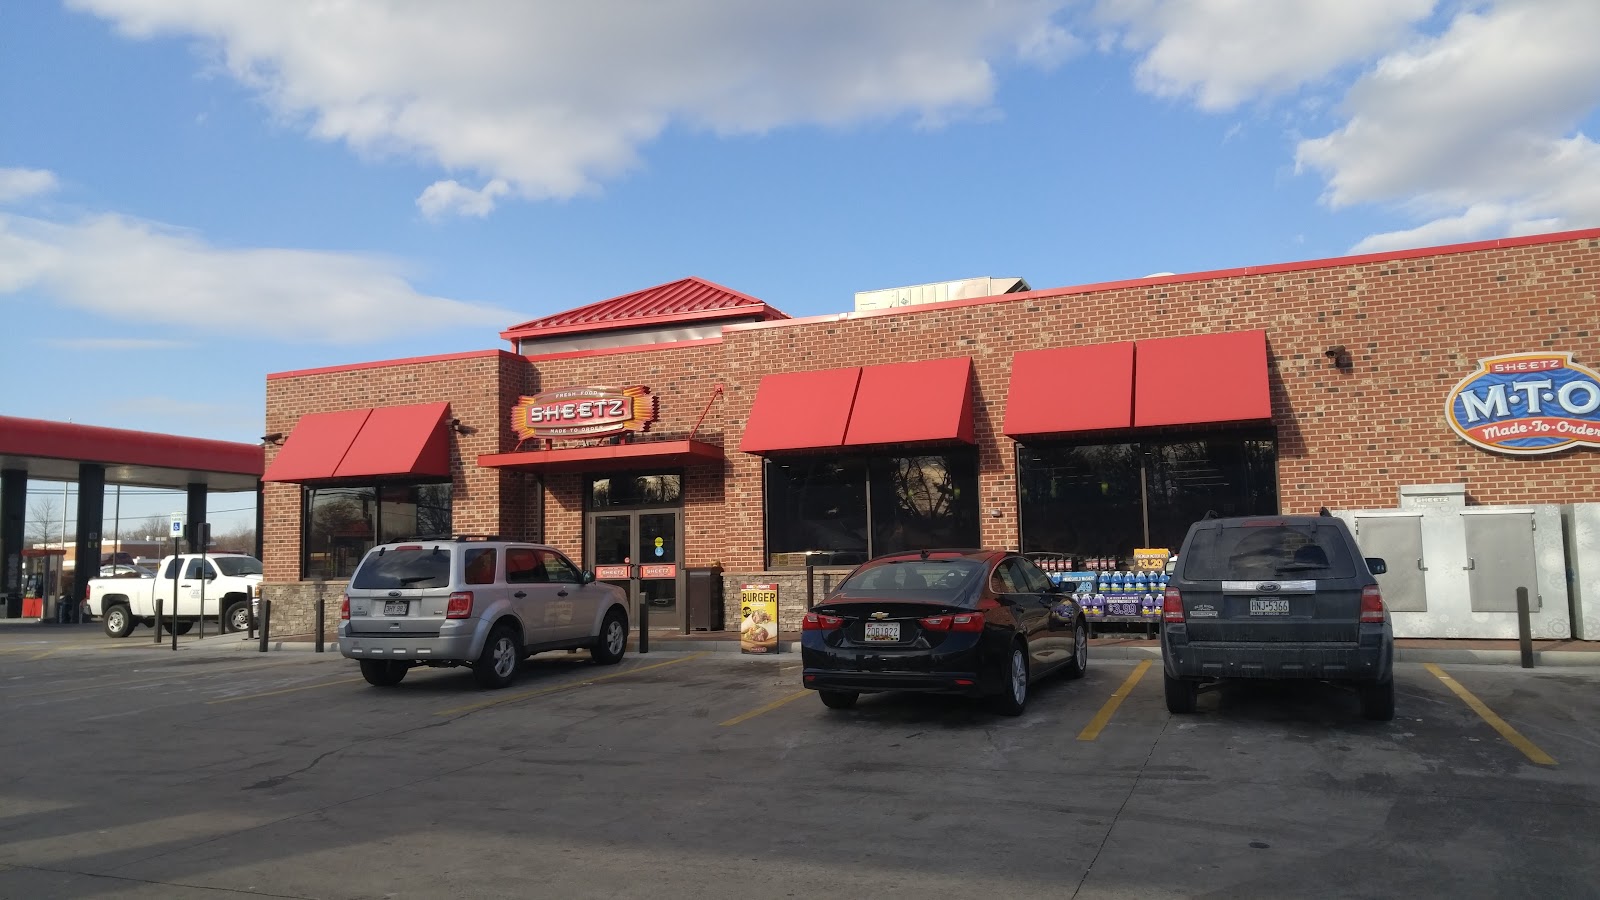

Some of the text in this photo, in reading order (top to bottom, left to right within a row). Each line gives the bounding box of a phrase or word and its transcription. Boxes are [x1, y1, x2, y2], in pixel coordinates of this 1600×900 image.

[1495, 360, 1559, 372] SHEETZ
[532, 399, 623, 422] SHEETZ
[1137, 559, 1163, 569] $3.29
[742, 592, 776, 603] BURGER
[1108, 603, 1137, 615] $3.99
